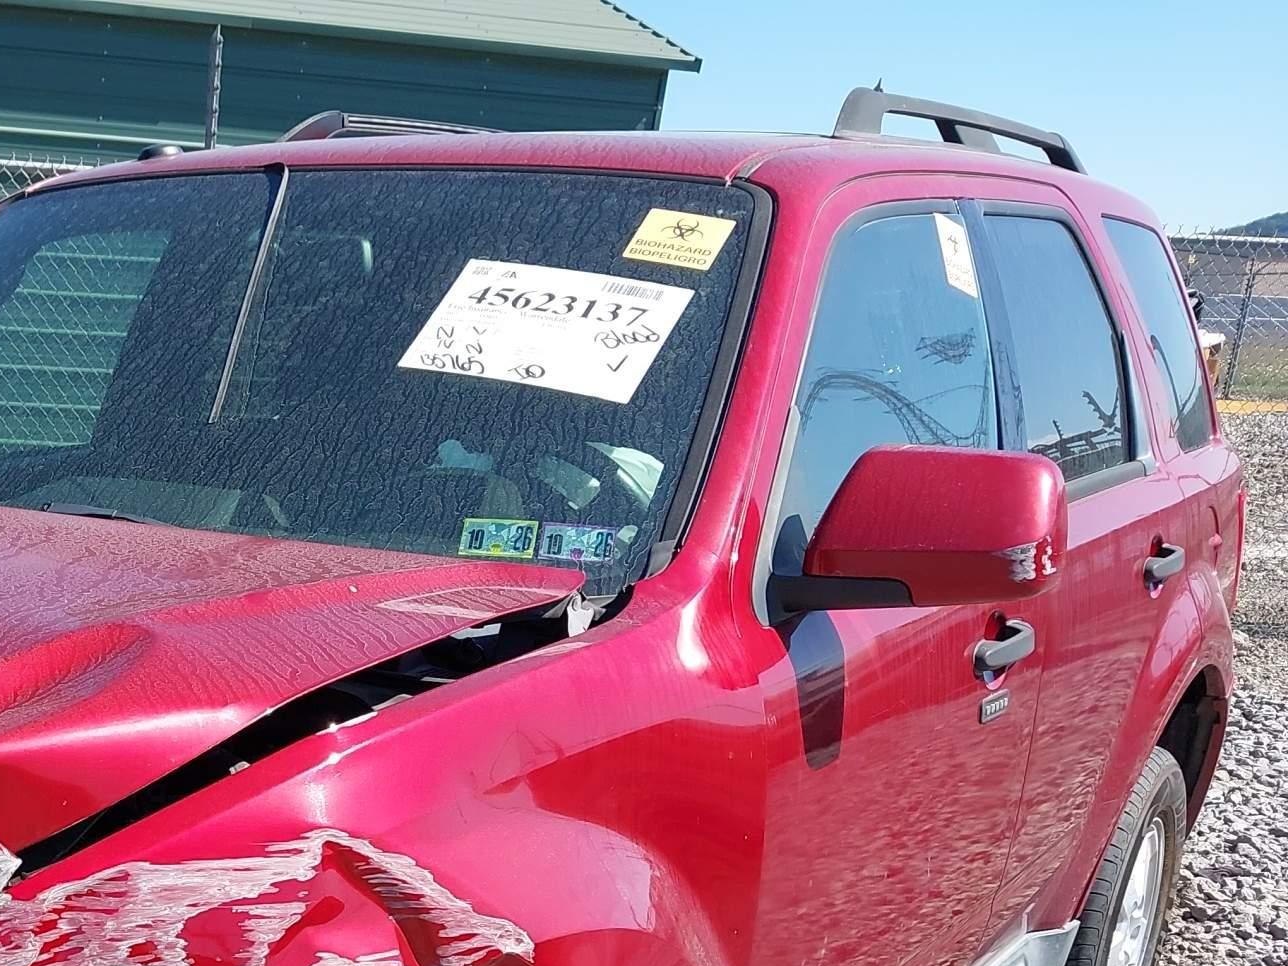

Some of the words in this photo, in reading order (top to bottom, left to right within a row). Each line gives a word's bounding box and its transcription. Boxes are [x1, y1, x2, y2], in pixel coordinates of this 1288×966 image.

[629, 247, 707, 266] BIOPELIGRO
[635, 238, 712, 257] BIOHAZARD
[468, 286, 649, 327] 45623137
[513, 525, 533, 551] 26
[593, 531, 613, 556] 26
